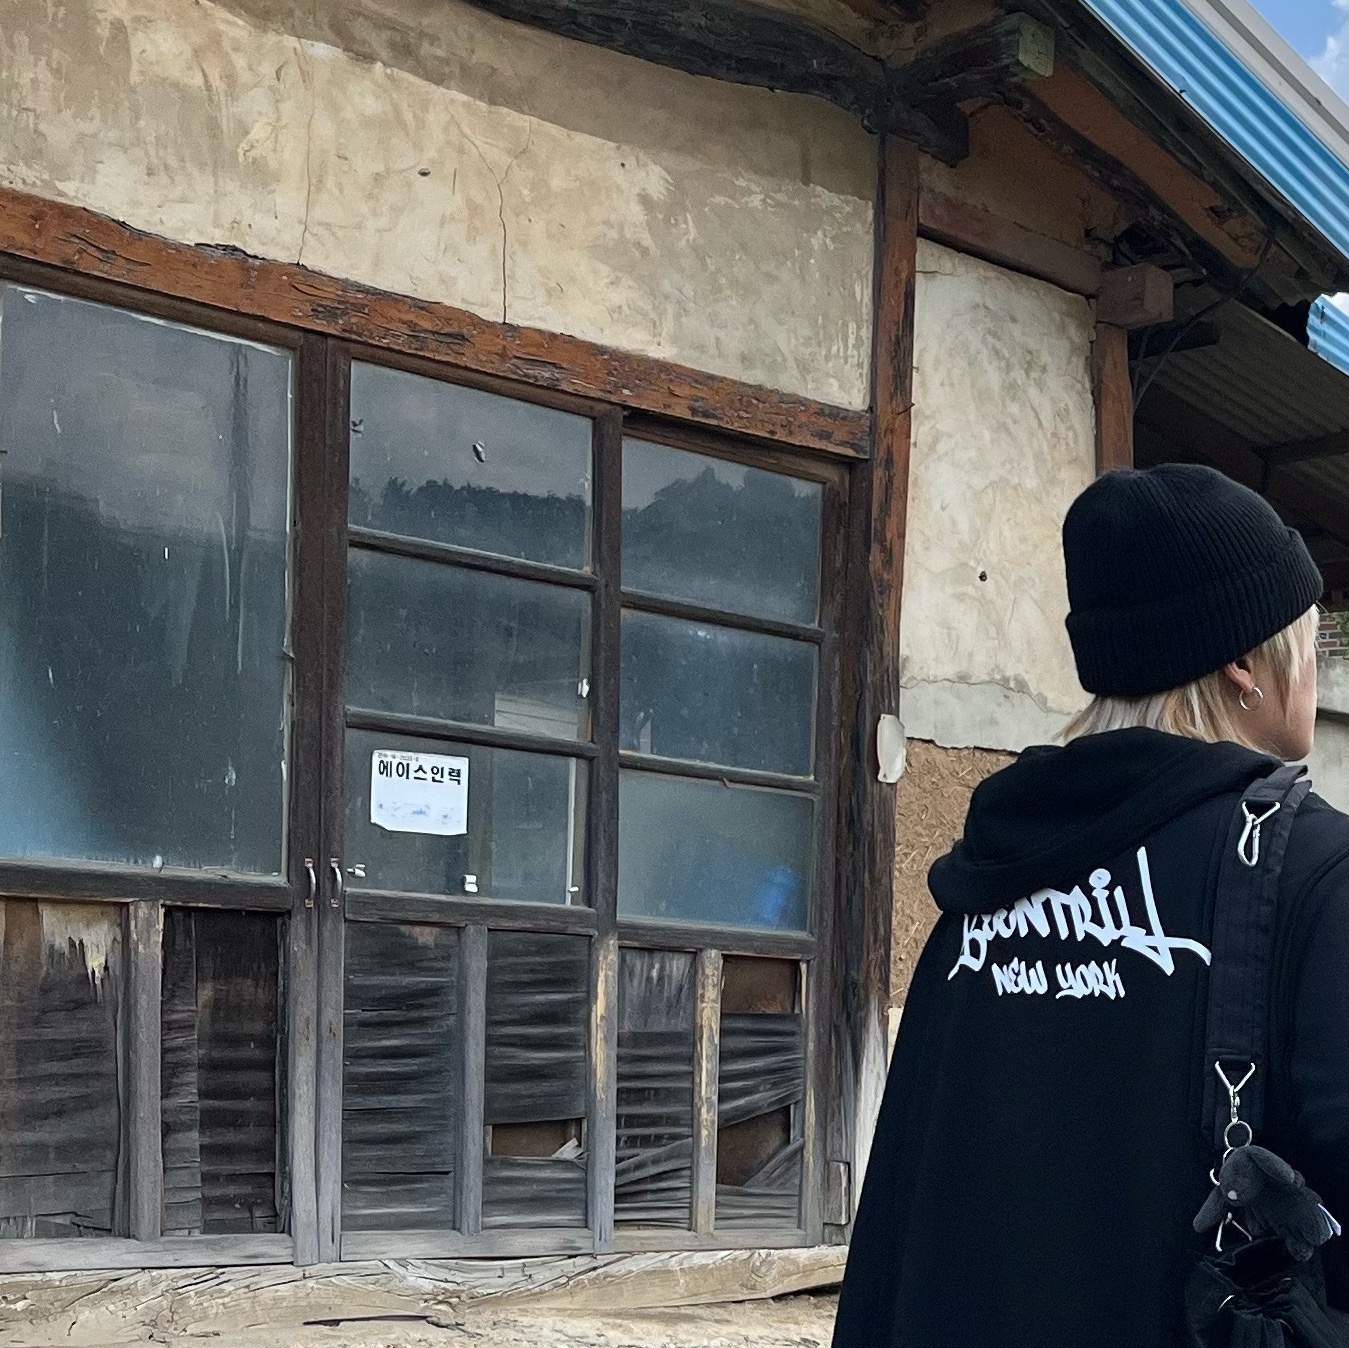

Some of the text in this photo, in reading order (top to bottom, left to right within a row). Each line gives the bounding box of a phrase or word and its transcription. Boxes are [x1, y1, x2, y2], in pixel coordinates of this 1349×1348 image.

[379, 760, 461, 785] 에이스인력
[991, 957, 1126, 1000] NEW YORK
